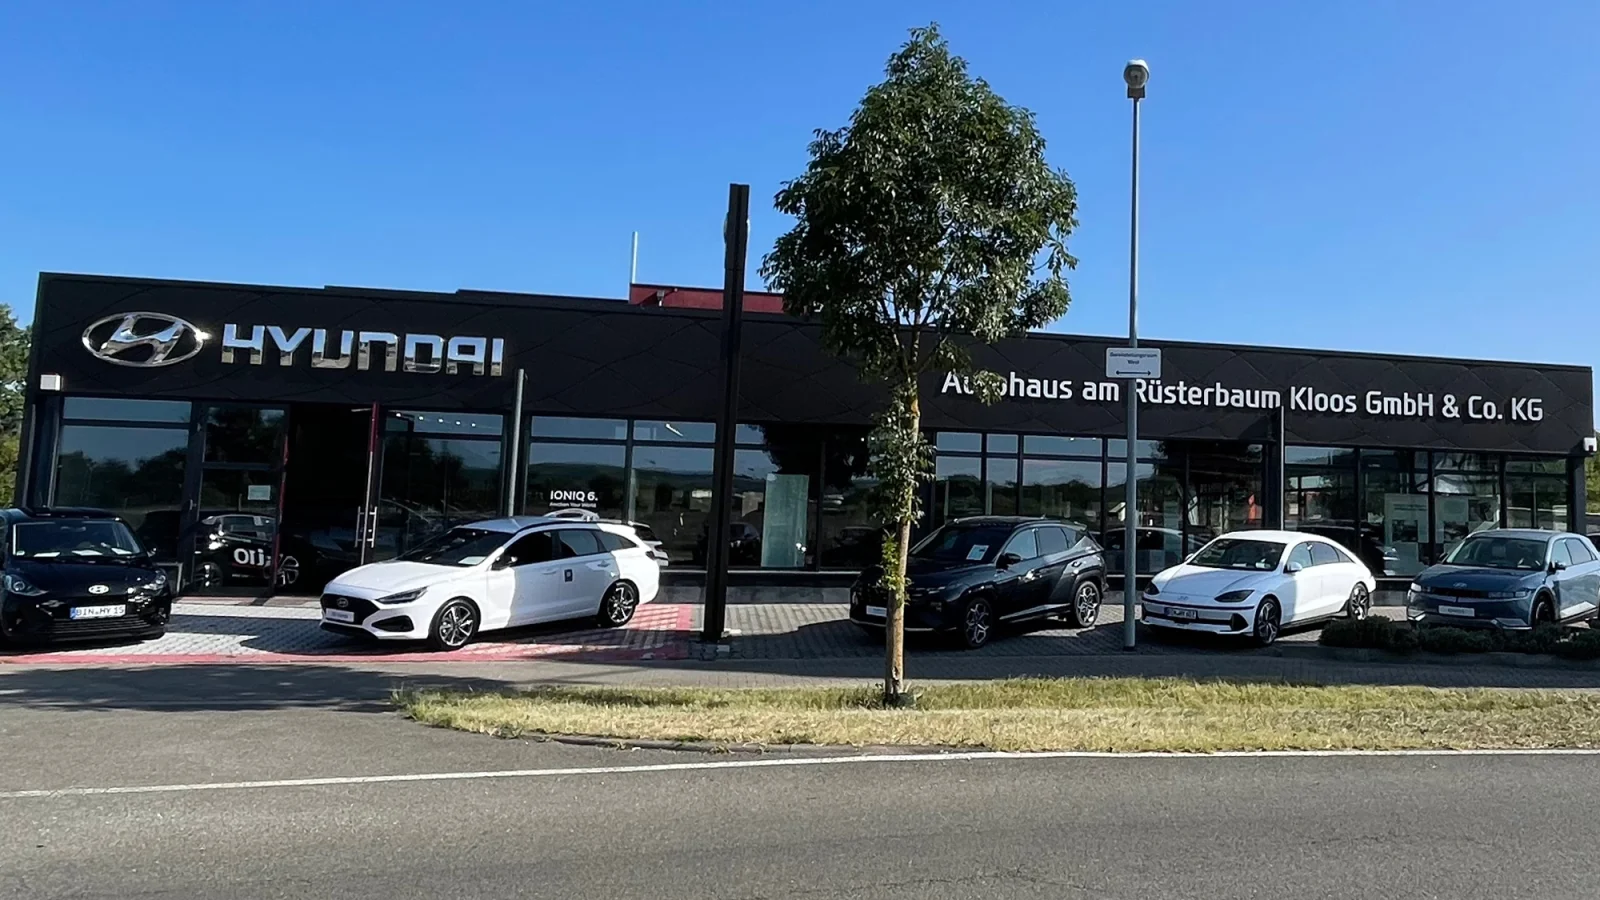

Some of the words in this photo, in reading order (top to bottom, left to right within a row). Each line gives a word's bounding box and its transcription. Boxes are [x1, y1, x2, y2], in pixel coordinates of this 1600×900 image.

[221, 323, 504, 377] HYUNDAI
[941, 370, 1073, 400] Auhaus
[1082, 381, 1119, 402] am
[1135, 379, 1281, 409] Rüsterbaum
[1290, 386, 1357, 413] Kloos
[1365, 391, 1434, 417] GmbH
[1441, 395, 1461, 418] &
[1468, 396, 1503, 420] Co.
[1511, 397, 1543, 421] KG
[550, 490, 585, 502] IONIQ
[588, 491, 598, 501] 6.
